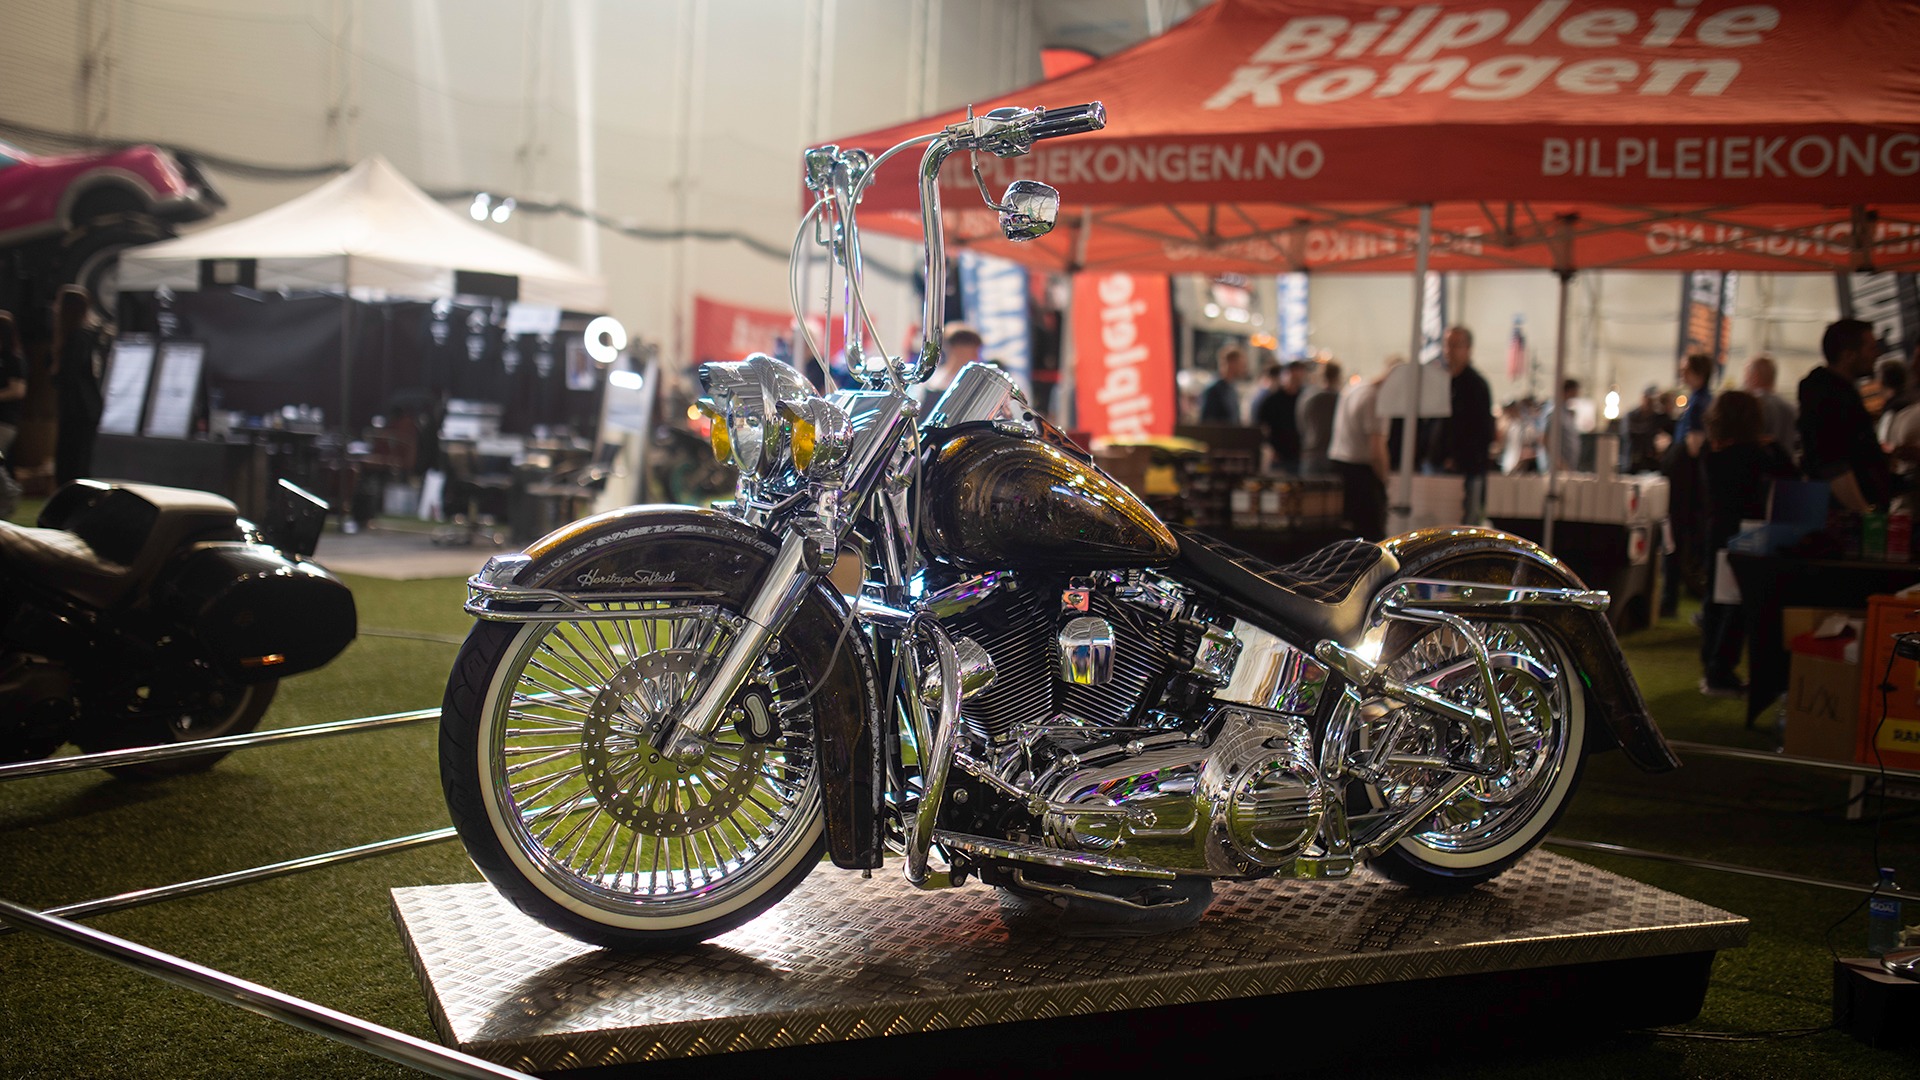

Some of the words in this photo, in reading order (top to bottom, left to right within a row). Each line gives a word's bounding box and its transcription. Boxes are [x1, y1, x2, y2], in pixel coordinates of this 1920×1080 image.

[1249, 0, 1781, 63] Bilpleie
[1203, 55, 1741, 109] Kongen
[942, 140, 1323, 188] ILPLEIEKONGEN.NO
[1541, 133, 1920, 179] BILPLEIEKONG
[577, 569, 634, 587] Heritage
[634, 569, 676, 586] Softail
